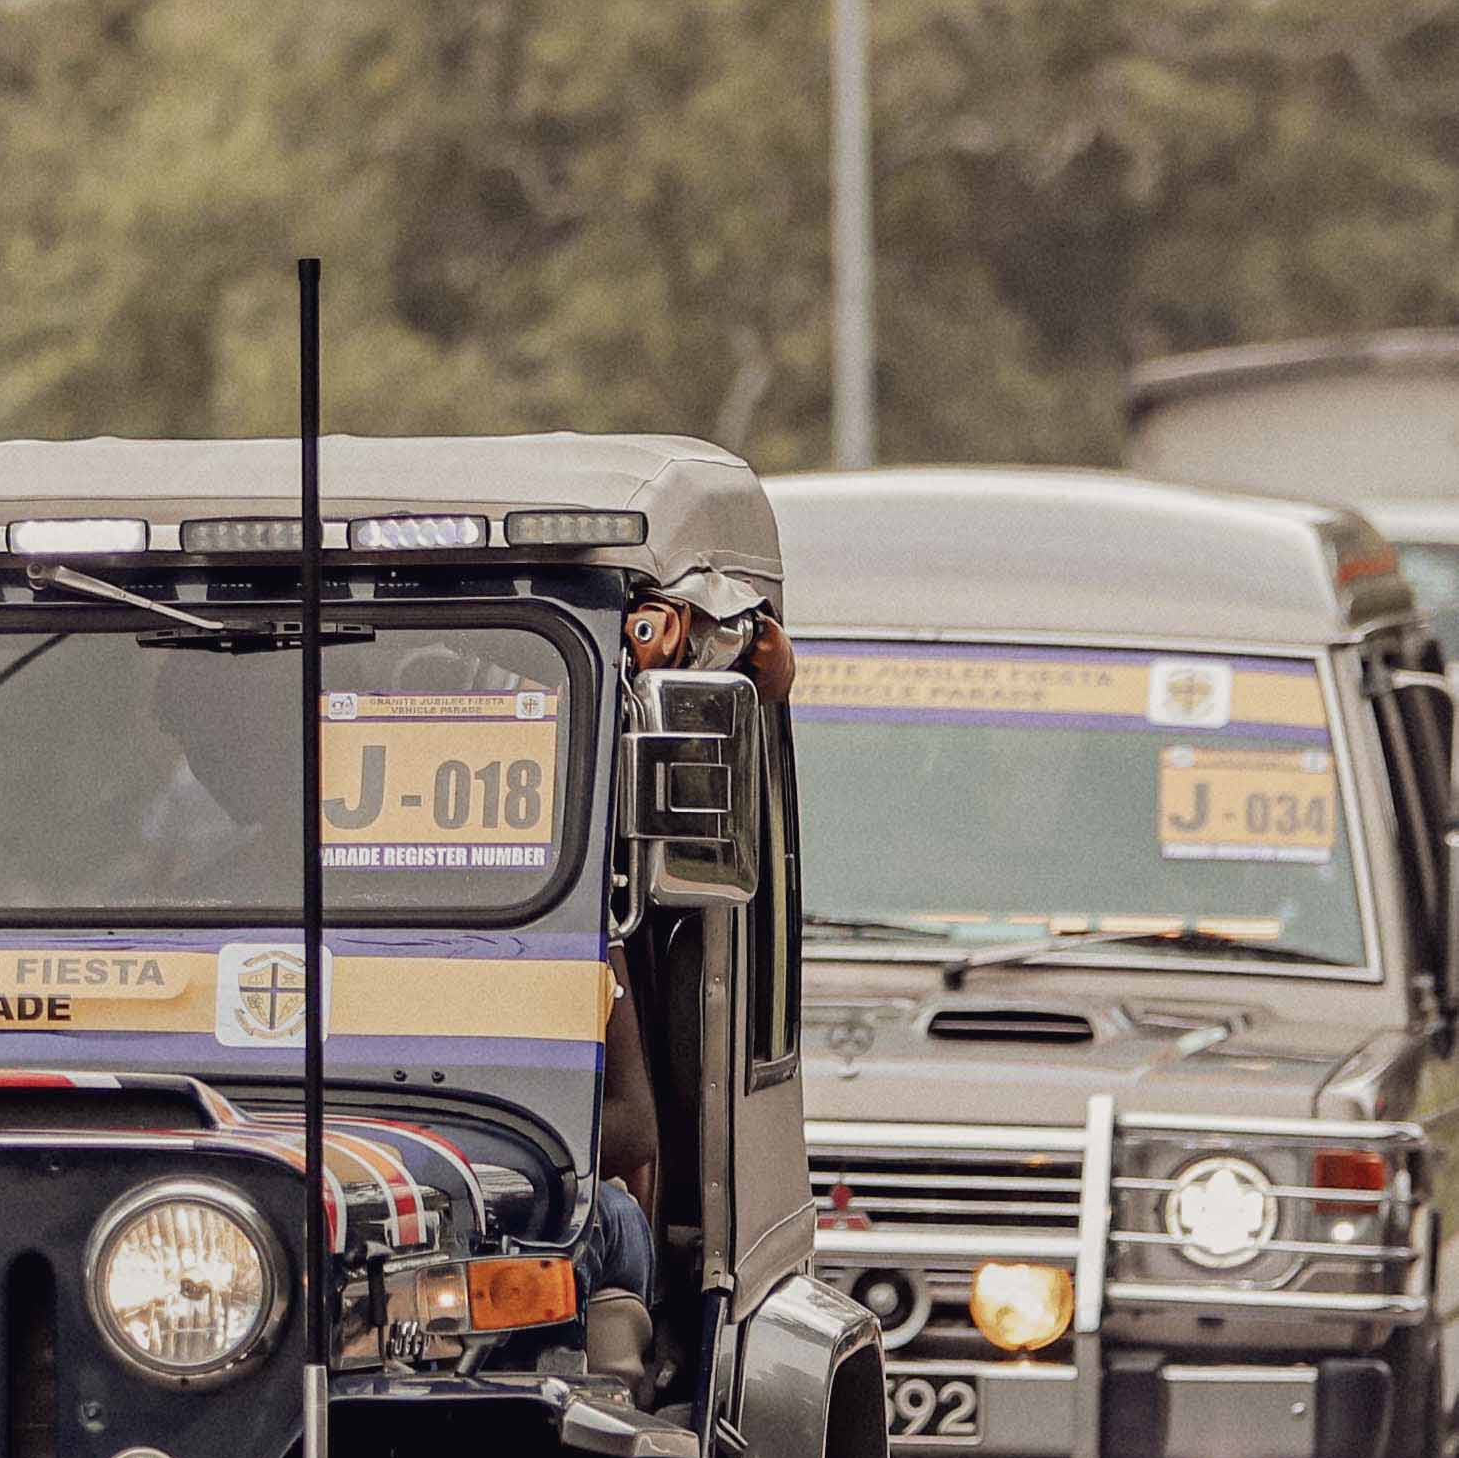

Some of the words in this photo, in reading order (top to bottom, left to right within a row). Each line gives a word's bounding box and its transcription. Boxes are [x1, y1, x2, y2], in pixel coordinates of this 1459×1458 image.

[322, 847, 381, 867] ARADE
[383, 847, 468, 867] REGISTER
[471, 847, 546, 867] NUMBER
[16, 958, 166, 986] FIESTA
